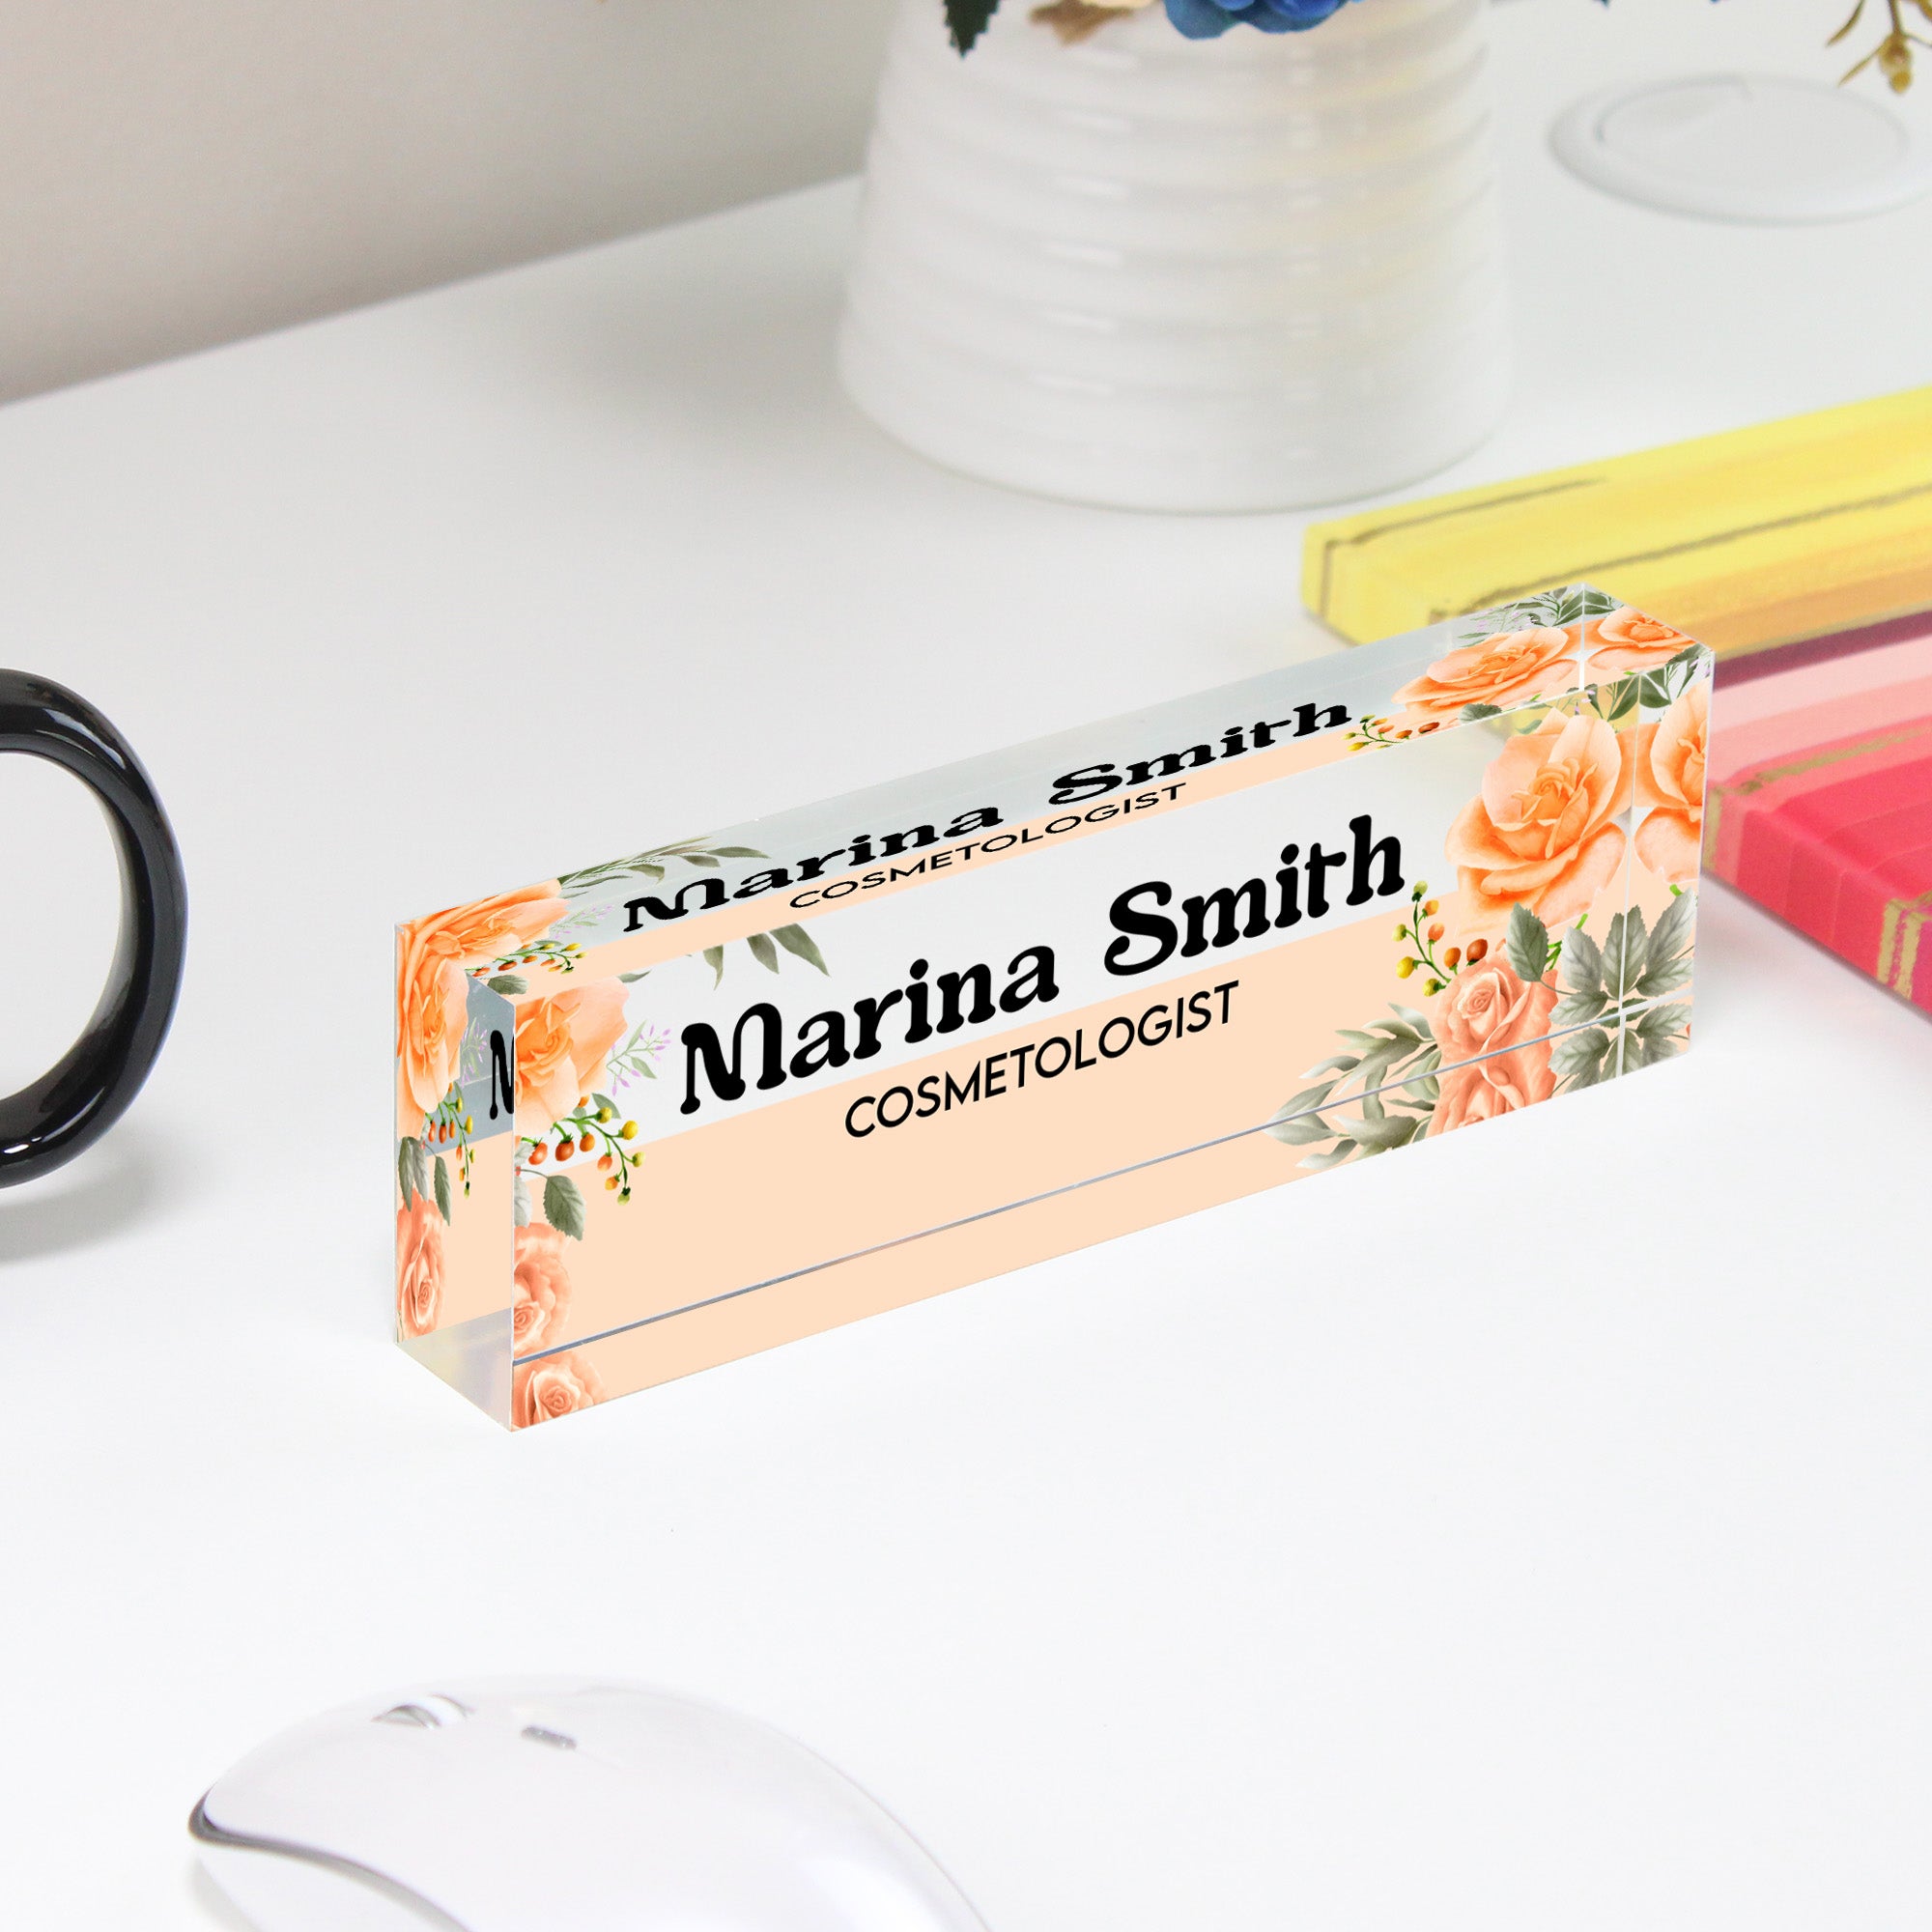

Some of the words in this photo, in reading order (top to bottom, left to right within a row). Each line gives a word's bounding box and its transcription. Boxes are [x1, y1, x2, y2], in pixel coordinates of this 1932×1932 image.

[623, 802, 1004, 932] Marina
[1048, 702, 1352, 806] Smith
[788, 782, 1187, 909] COSMETOLOGIST
[680, 946, 1060, 1115] Marina
[1104, 814, 1406, 977] Smith
[845, 980, 1239, 1139] COSMETOLOGIST
